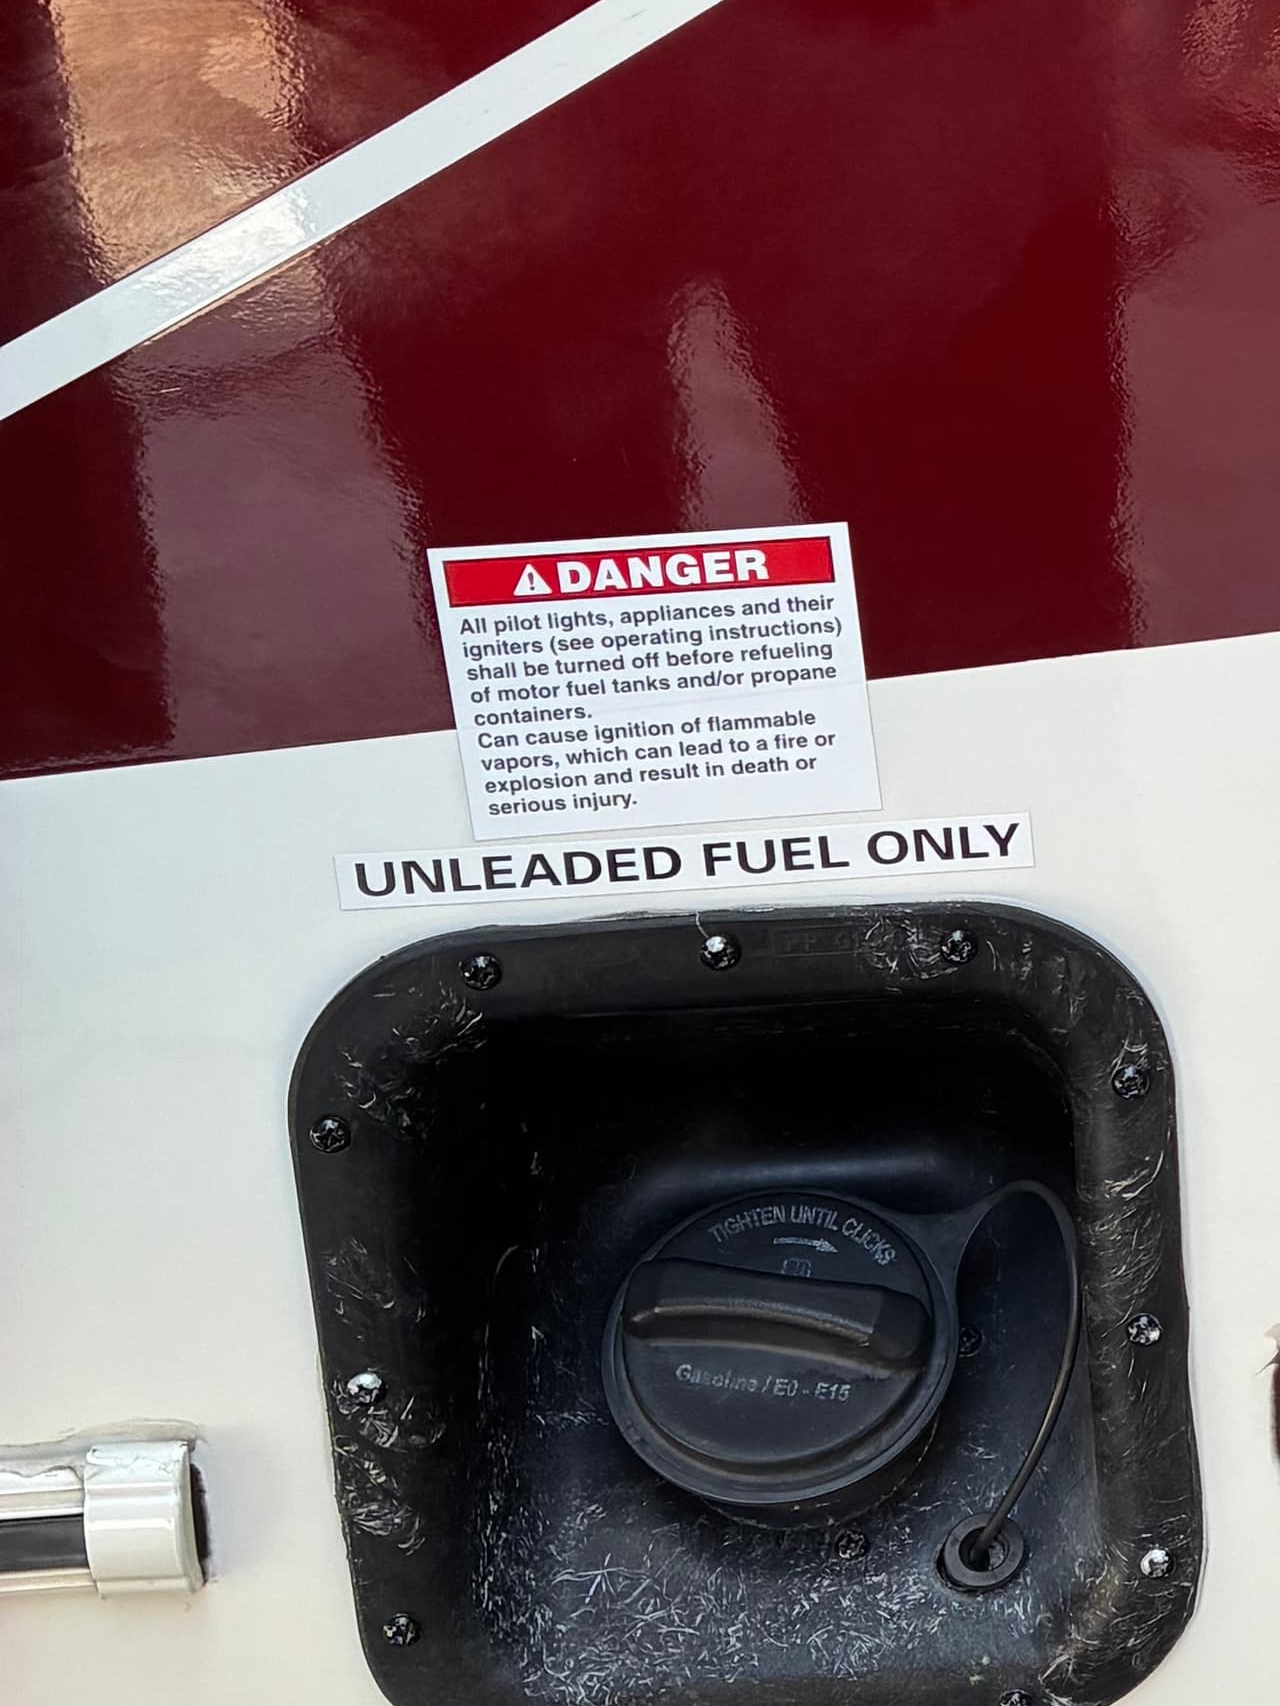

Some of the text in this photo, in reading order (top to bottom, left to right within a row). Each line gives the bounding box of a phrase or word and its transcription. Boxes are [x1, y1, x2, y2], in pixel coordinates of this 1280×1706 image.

[556, 549, 769, 593] DANGER
[460, 595, 834, 636] All pilot lights, appliances and their
[462, 617, 842, 662] igniters (see operating instructions)
[467, 642, 833, 681] shall be turned off before refueling
[471, 666, 837, 703] of motor fuel tanks and/or propane
[474, 706, 592, 726] containers.
[478, 710, 816, 749] Can cause ignition of flammable
[481, 733, 836, 773] vapors, which can lead to a fire or
[485, 755, 817, 796] explosion and result in death or
[489, 792, 637, 815] serious injury.
[355, 823, 1019, 897] UNLEADED FUEL ONLY
[708, 1205, 896, 1265] TIGHTEN UNTIL CLICKS
[675, 1364, 757, 1392] Gasoline
[815, 1382, 851, 1401] E15
